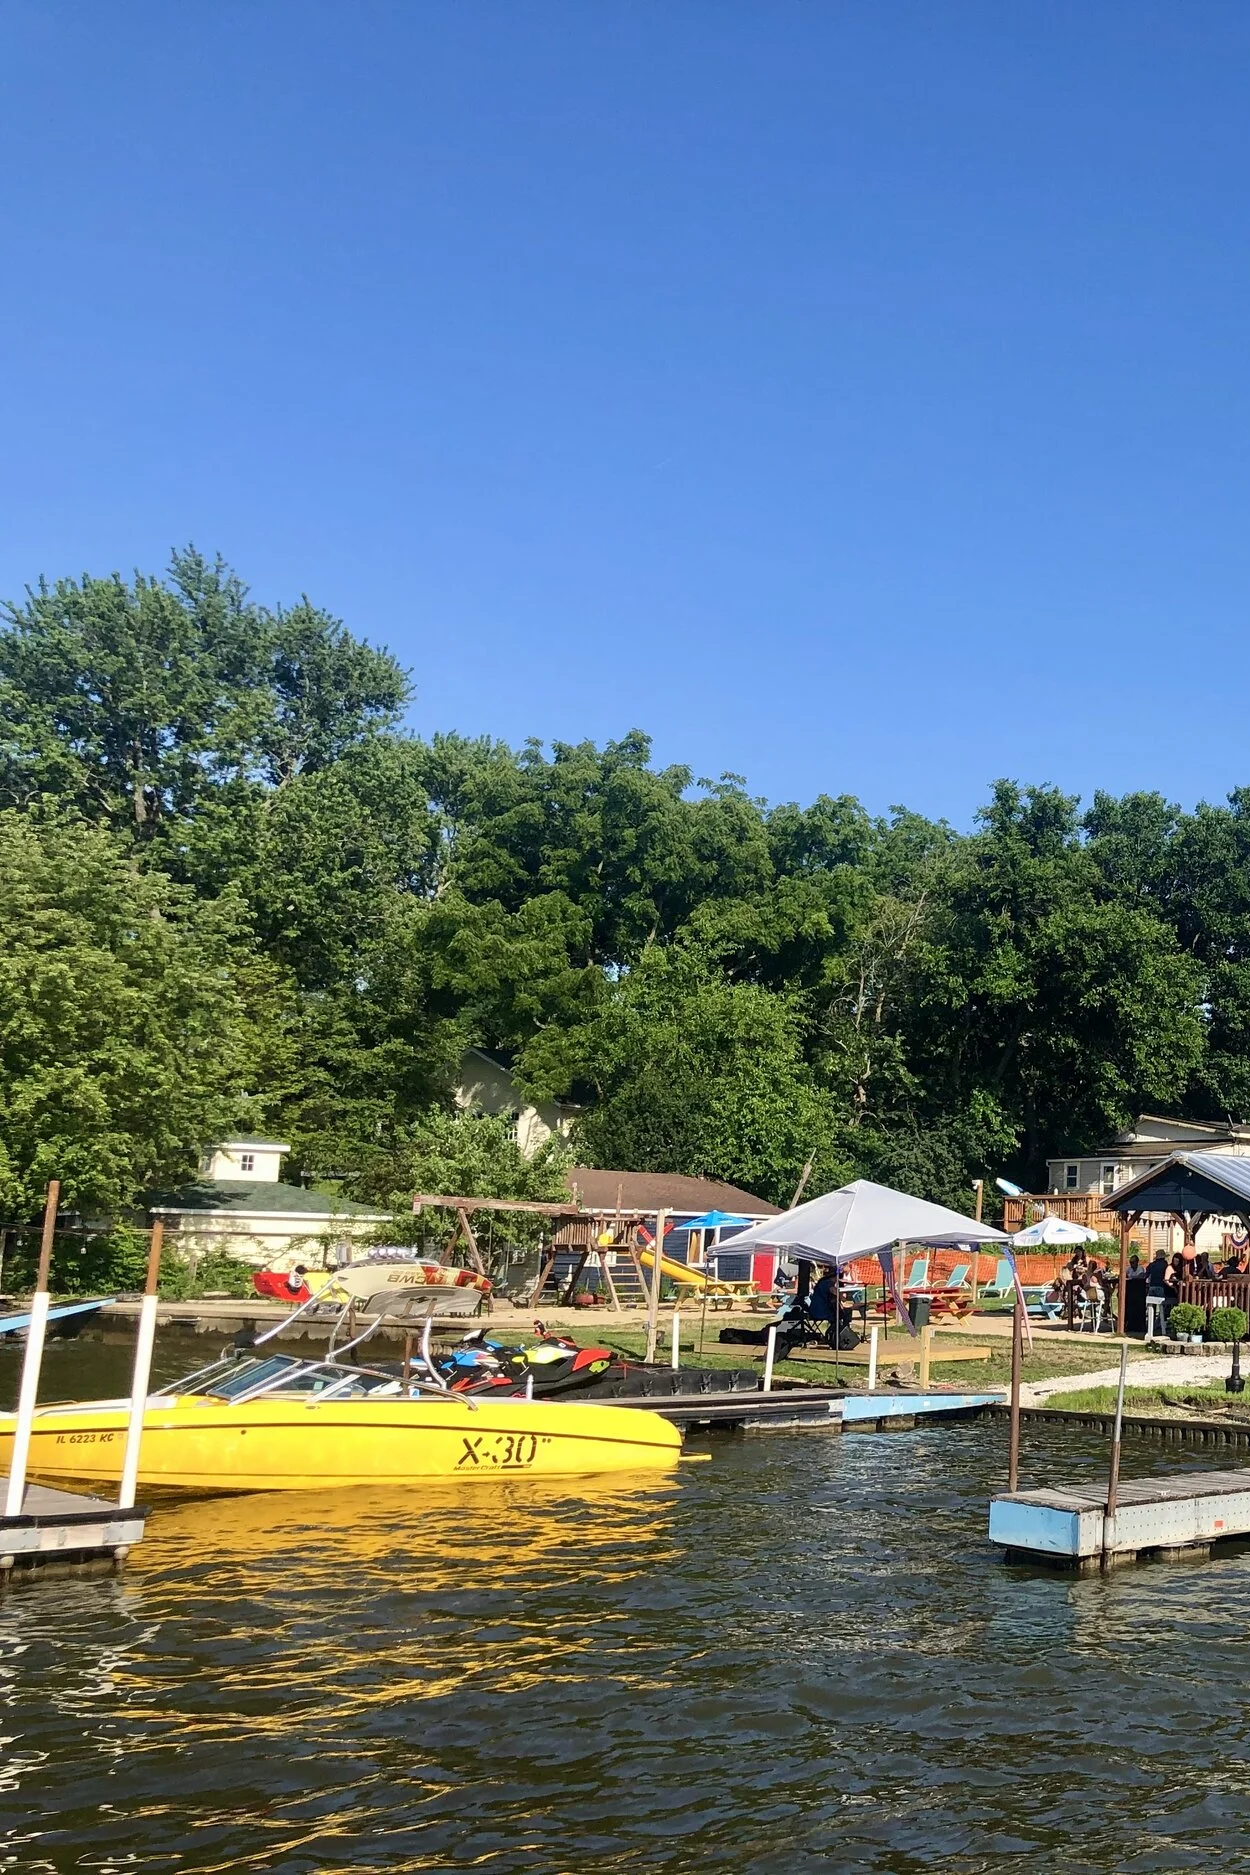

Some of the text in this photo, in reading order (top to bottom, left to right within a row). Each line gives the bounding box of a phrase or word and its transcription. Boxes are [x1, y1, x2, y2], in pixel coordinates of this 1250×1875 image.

[56, 1433, 115, 1444] IL 6223 KC
[453, 1464, 502, 1472] MasterCraft
